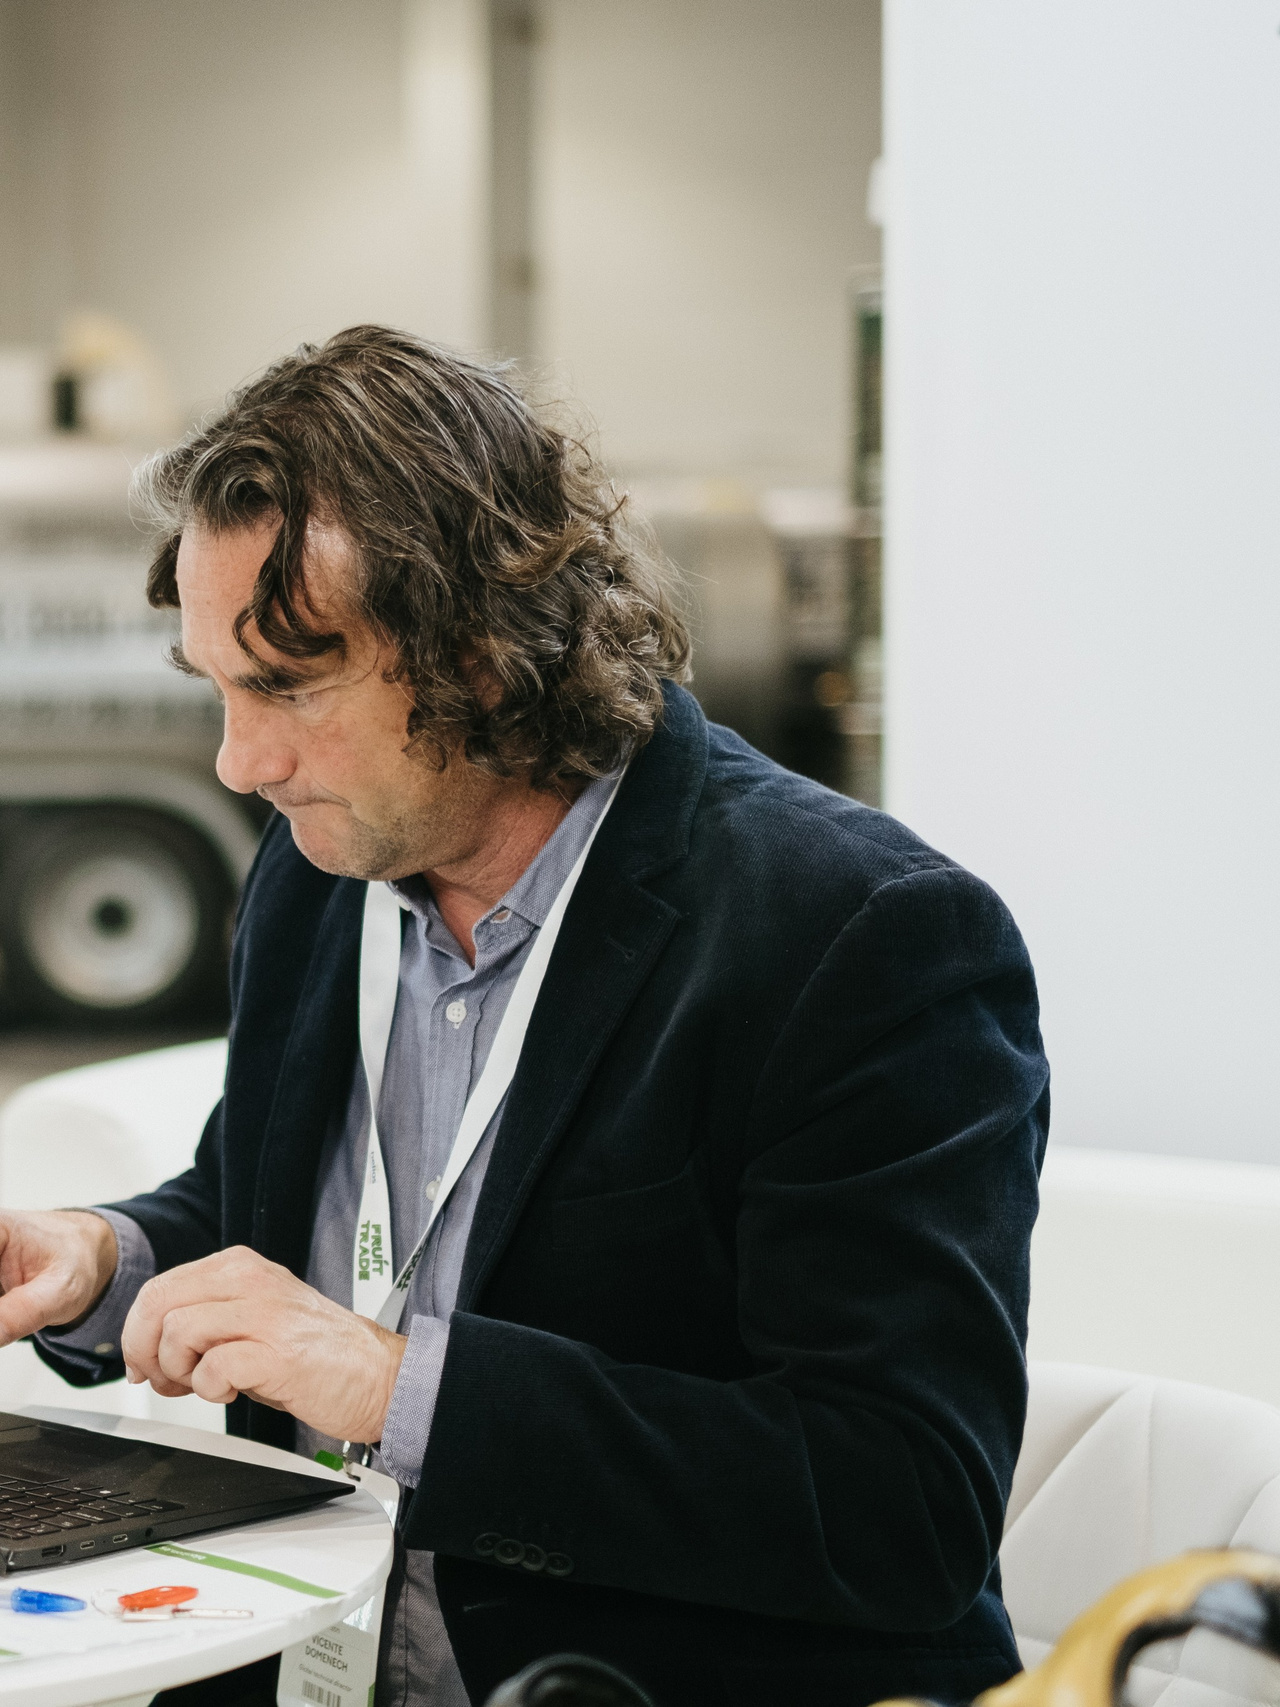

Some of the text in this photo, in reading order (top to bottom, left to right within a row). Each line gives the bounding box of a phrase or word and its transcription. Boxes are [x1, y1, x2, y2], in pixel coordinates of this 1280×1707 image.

[358, 1220, 371, 1281] TRADE
[305, 1645, 348, 1673] DOMENECH
[312, 1635, 343, 1656] VICENTE
